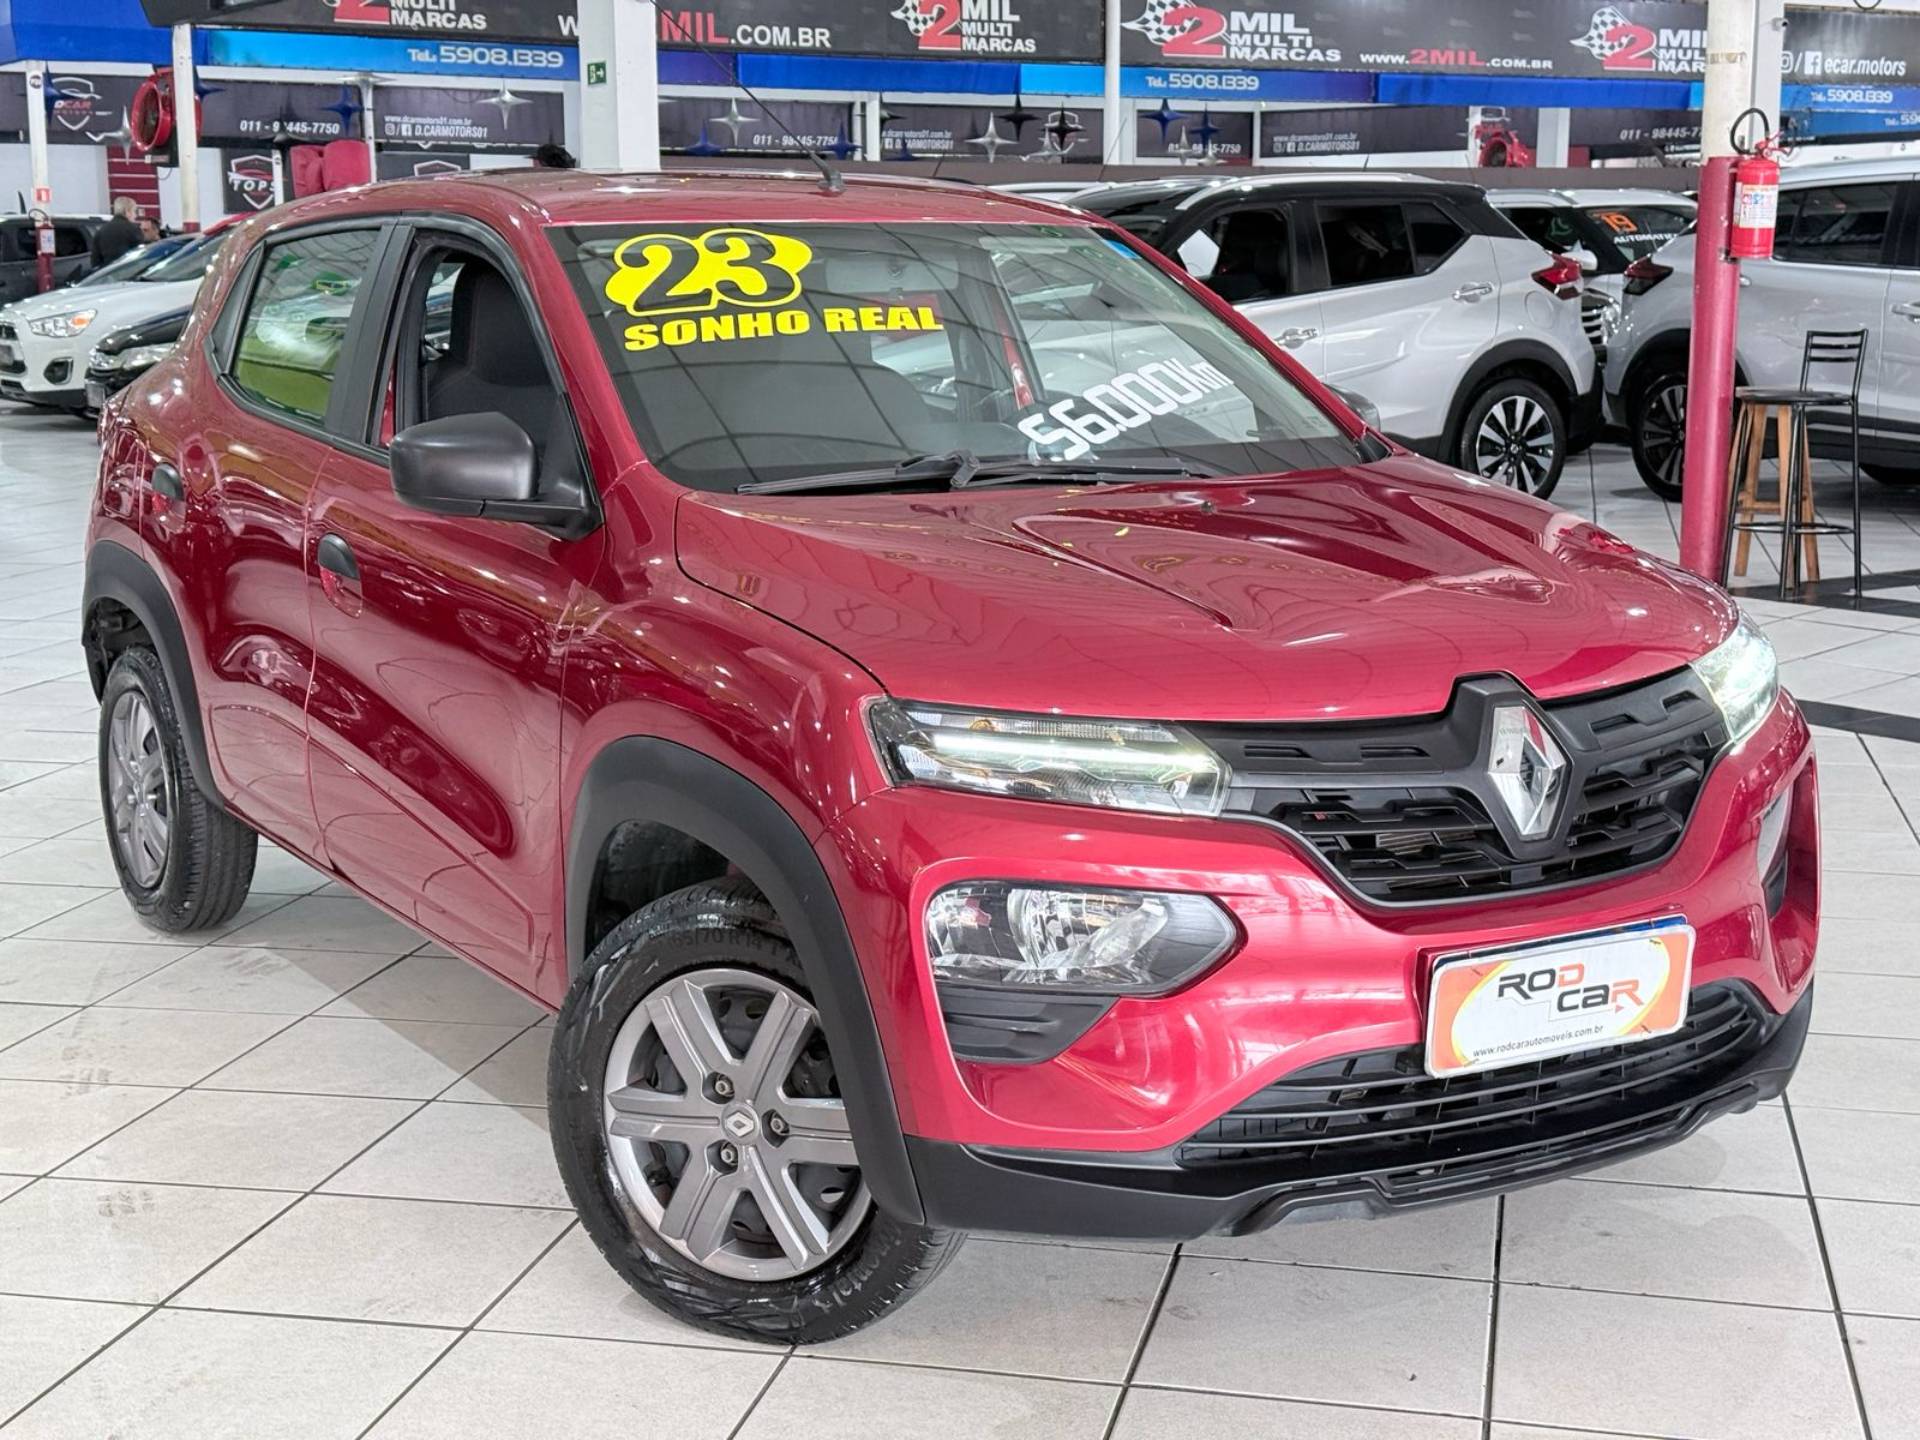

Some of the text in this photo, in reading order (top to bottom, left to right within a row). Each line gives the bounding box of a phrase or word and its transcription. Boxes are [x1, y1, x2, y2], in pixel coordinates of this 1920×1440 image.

[391, 10, 487, 30] MARCAS
[961, 0, 1020, 22] MIL
[961, 21, 1013, 37] MULTI
[1230, 11, 1310, 34] MIL
[1161, 7, 1227, 59] 2
[1230, 33, 1313, 49] MULTI
[961, 36, 1036, 53] MARCAS
[1230, 46, 1342, 62] MARCAS
[1602, 24, 1655, 71] 2
[439, 45, 564, 68] 5908.1339
[1658, 49, 1706, 61] MUL
[1657, 60, 1705, 73] MAR
[1824, 55, 1907, 76] ecar.motors
[1169, 73, 1260, 91] 5908.1339
[240, 120, 261, 132] 011
[273, 121, 341, 135] 9445-7750
[1620, 129, 1641, 141] 011
[752, 135, 772, 147] 011
[605, 227, 813, 317] 23
[624, 306, 945, 352] SONHO REAL
[1498, 963, 1585, 1000] ROD
[1472, 1023, 1604, 1058] www.rodcarautomoveis.com.br
